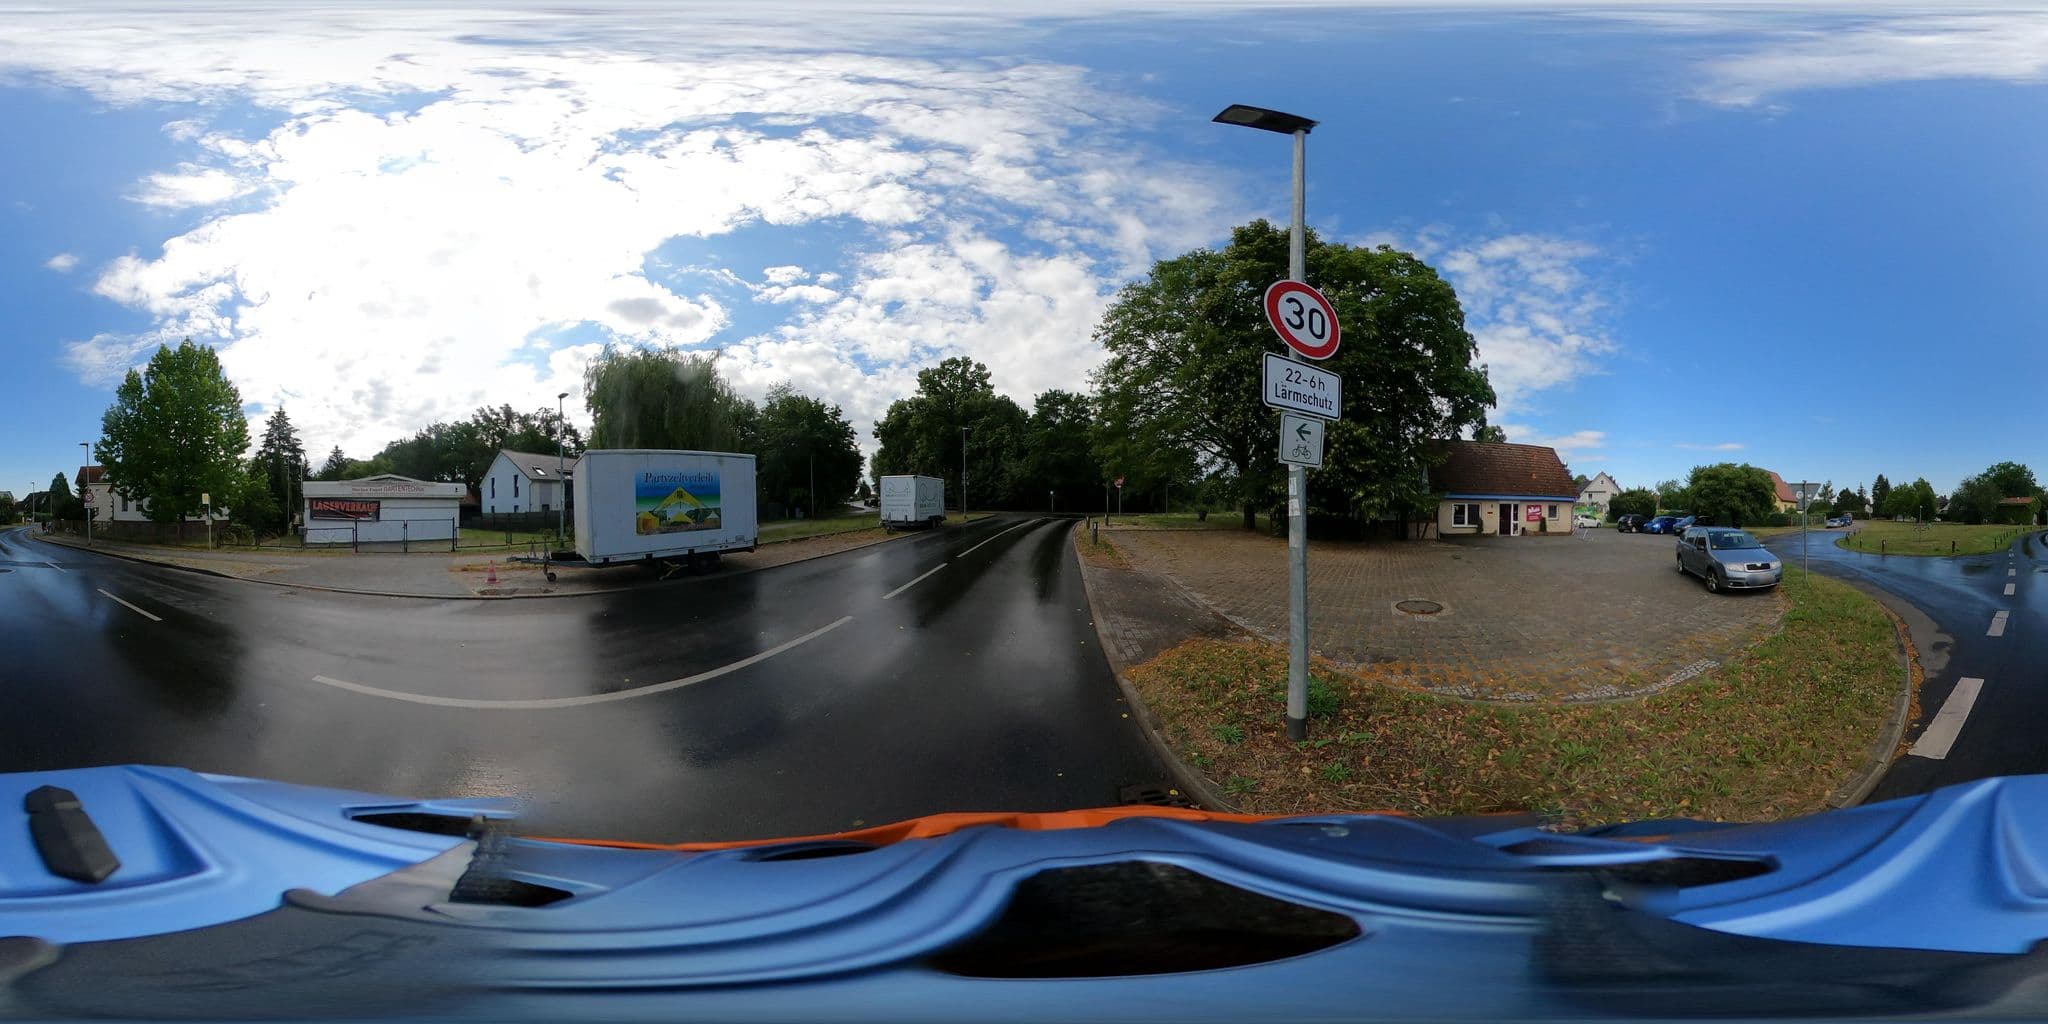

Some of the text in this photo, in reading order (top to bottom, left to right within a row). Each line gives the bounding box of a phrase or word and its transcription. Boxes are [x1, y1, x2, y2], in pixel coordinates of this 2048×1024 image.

[1285, 297, 1325, 340] 30
[1275, 382, 1333, 410] Lärmschutz
[645, 472, 713, 484] Partyzeltverleih
[313, 501, 377, 512] LAGERVERKAUF
